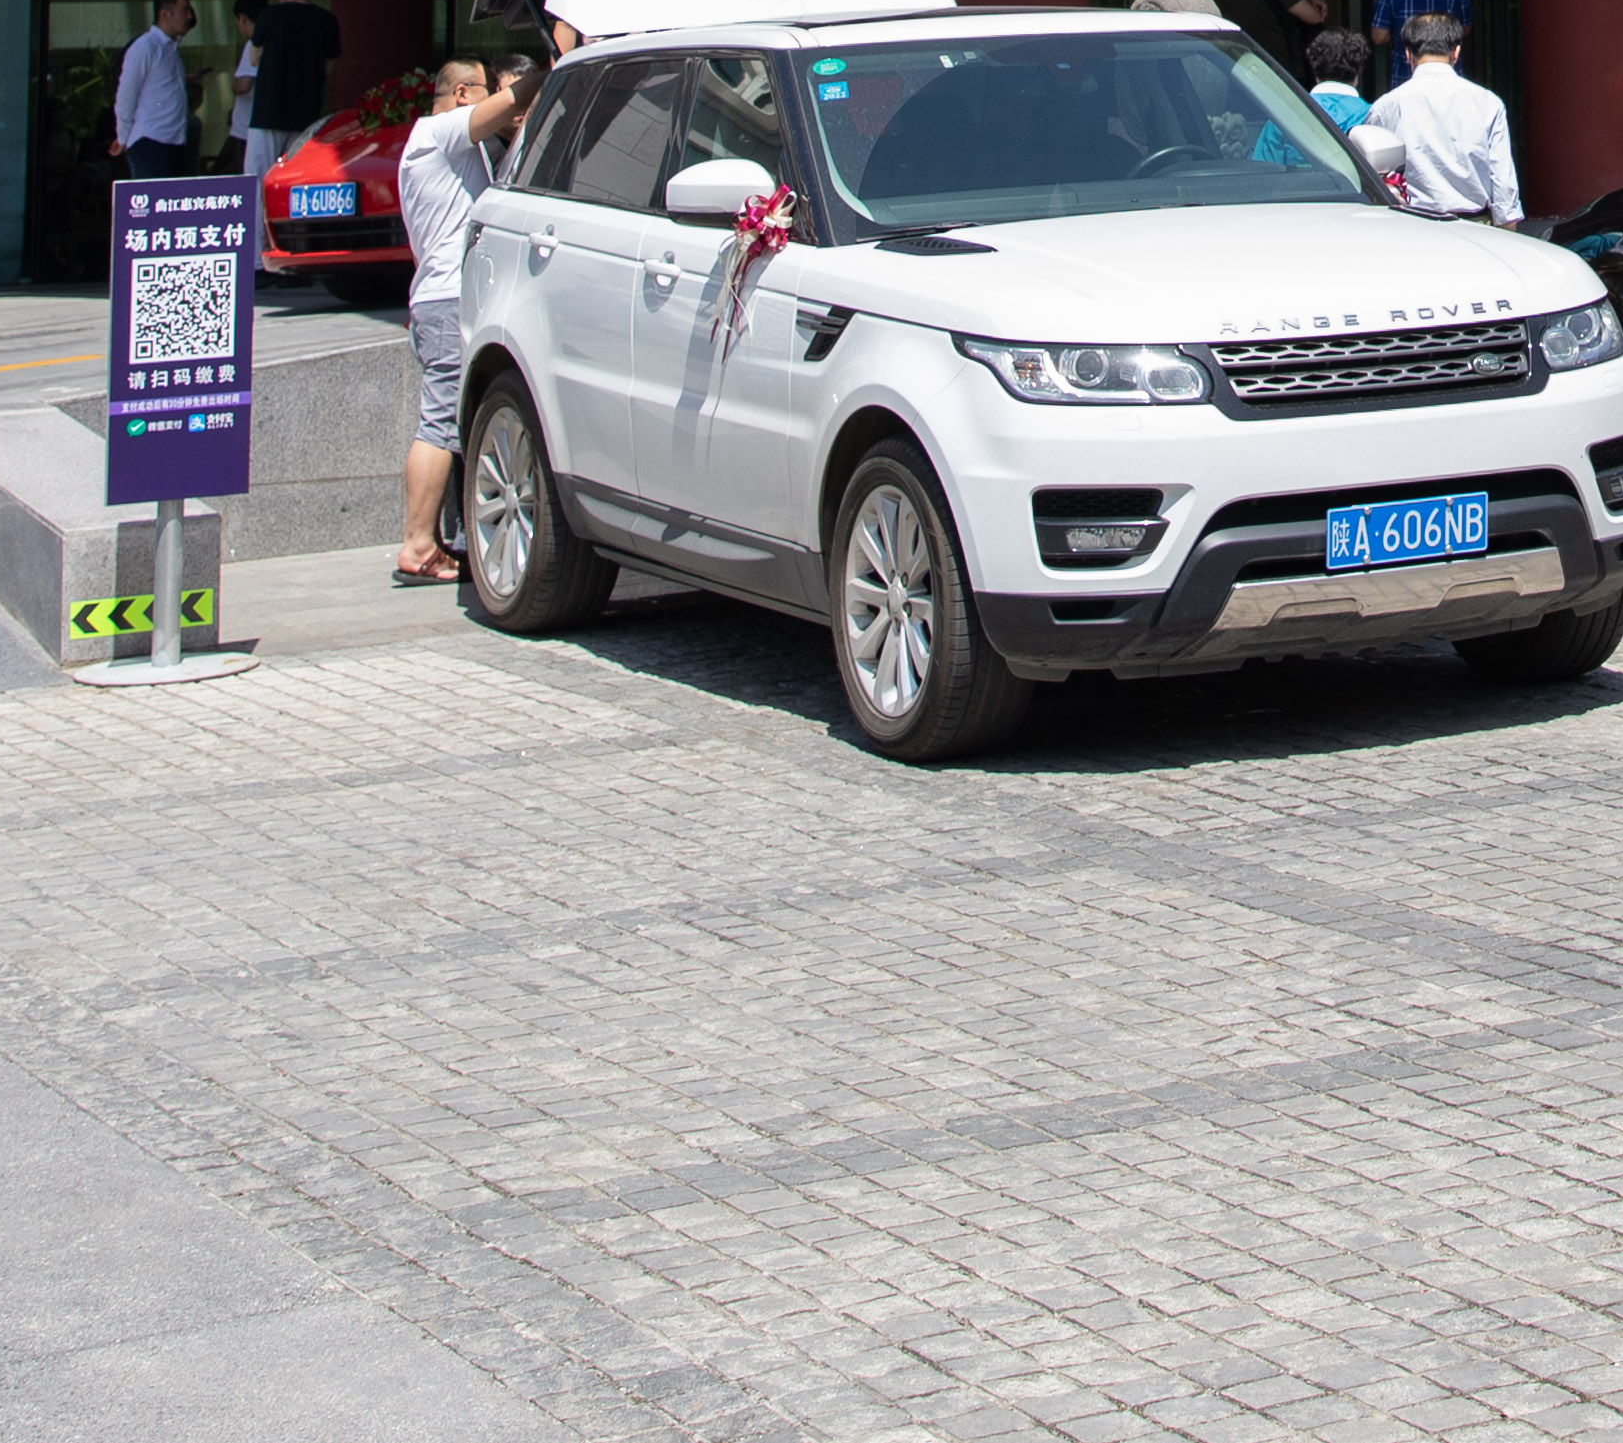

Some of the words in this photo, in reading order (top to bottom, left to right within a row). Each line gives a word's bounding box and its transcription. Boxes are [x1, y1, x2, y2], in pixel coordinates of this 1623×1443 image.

[124, 222, 247, 252] 场内预支付
[1219, 314, 1360, 335] RANGE
[1390, 299, 1513, 322] ROVER
[127, 364, 236, 391] 请扫码缴费
[1331, 503, 1484, 559] 陕A·606NB
